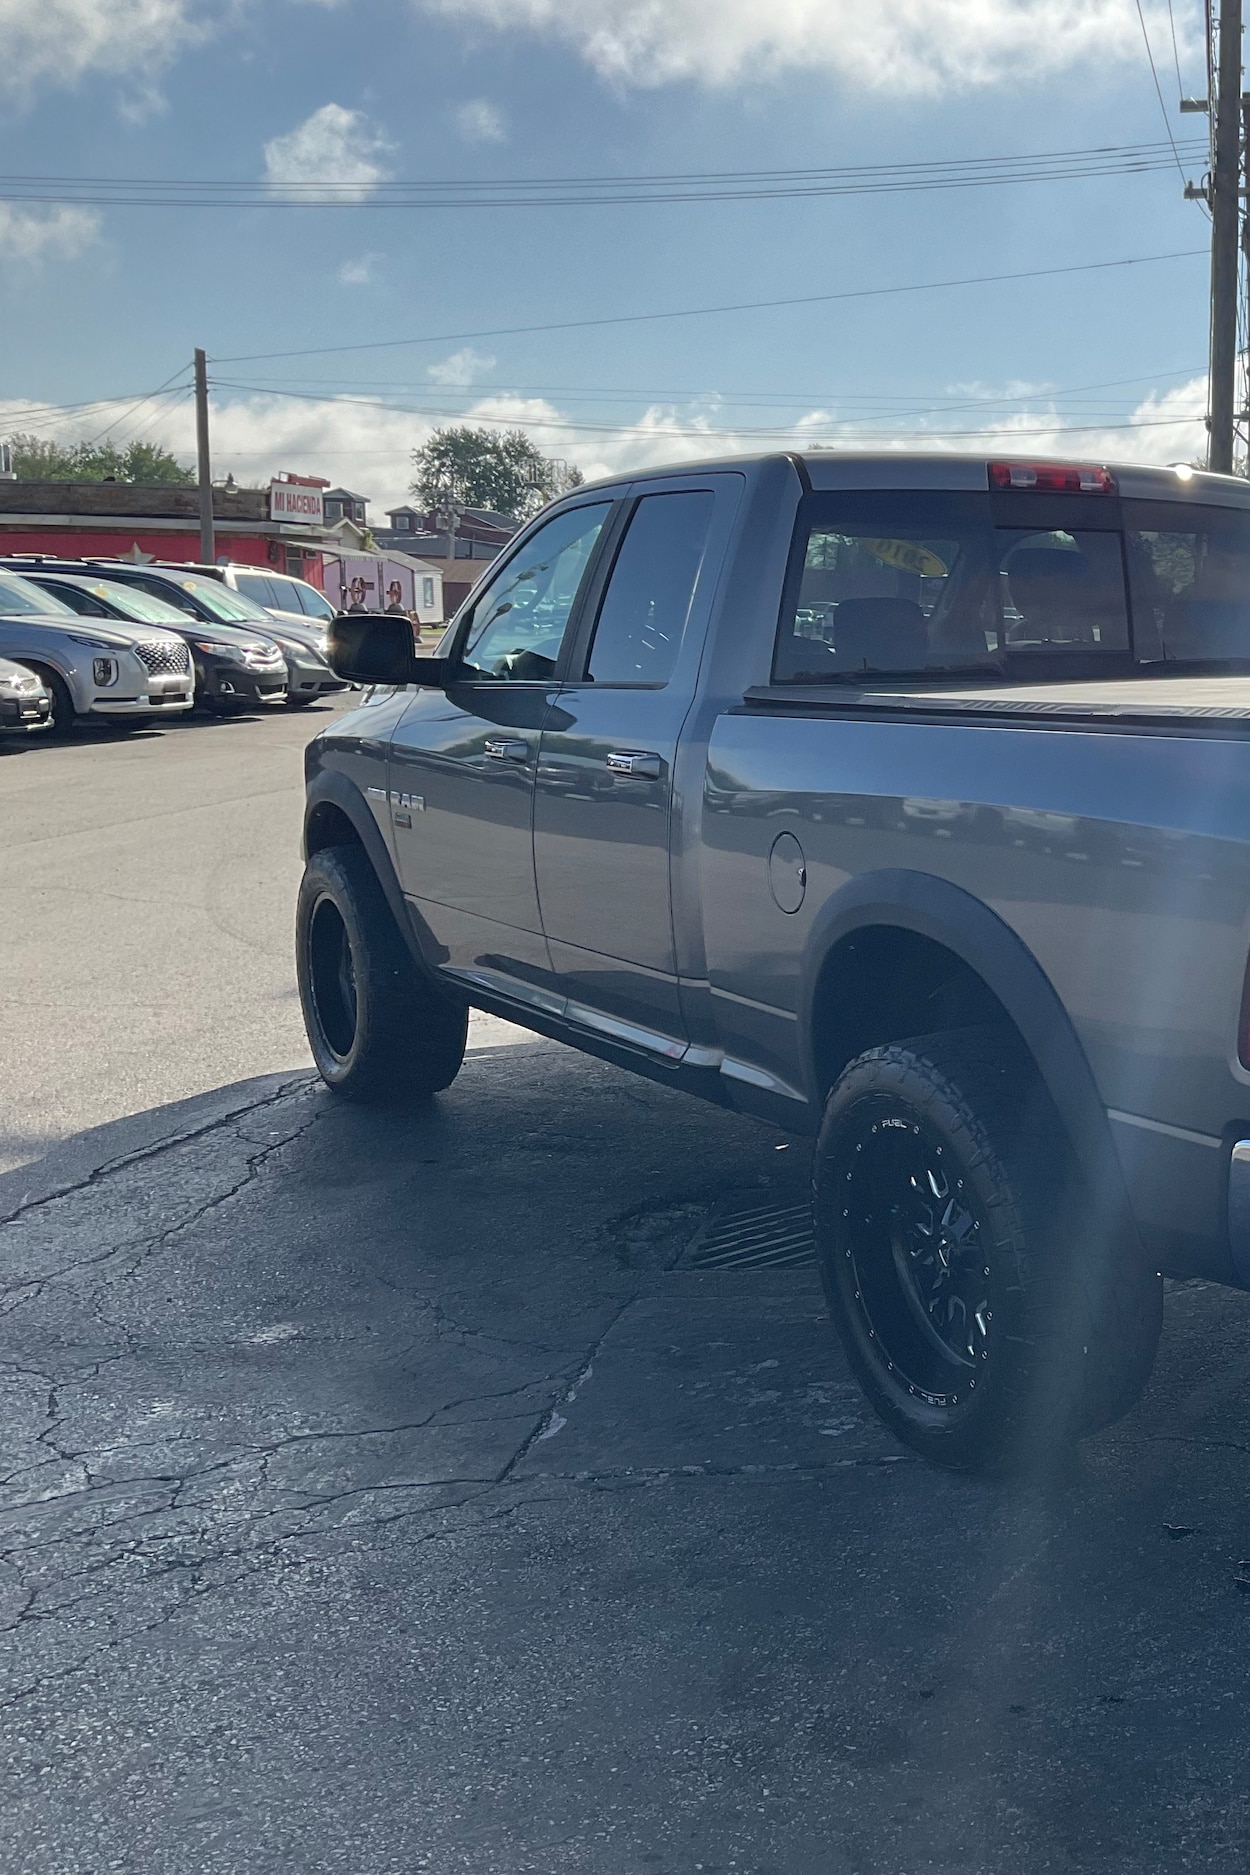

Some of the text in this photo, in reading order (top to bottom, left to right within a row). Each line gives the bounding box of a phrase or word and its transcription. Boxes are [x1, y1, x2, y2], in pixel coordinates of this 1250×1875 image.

[275, 491, 321, 516] MI HACIENDA
[881, 1118, 908, 1129] FUEL
